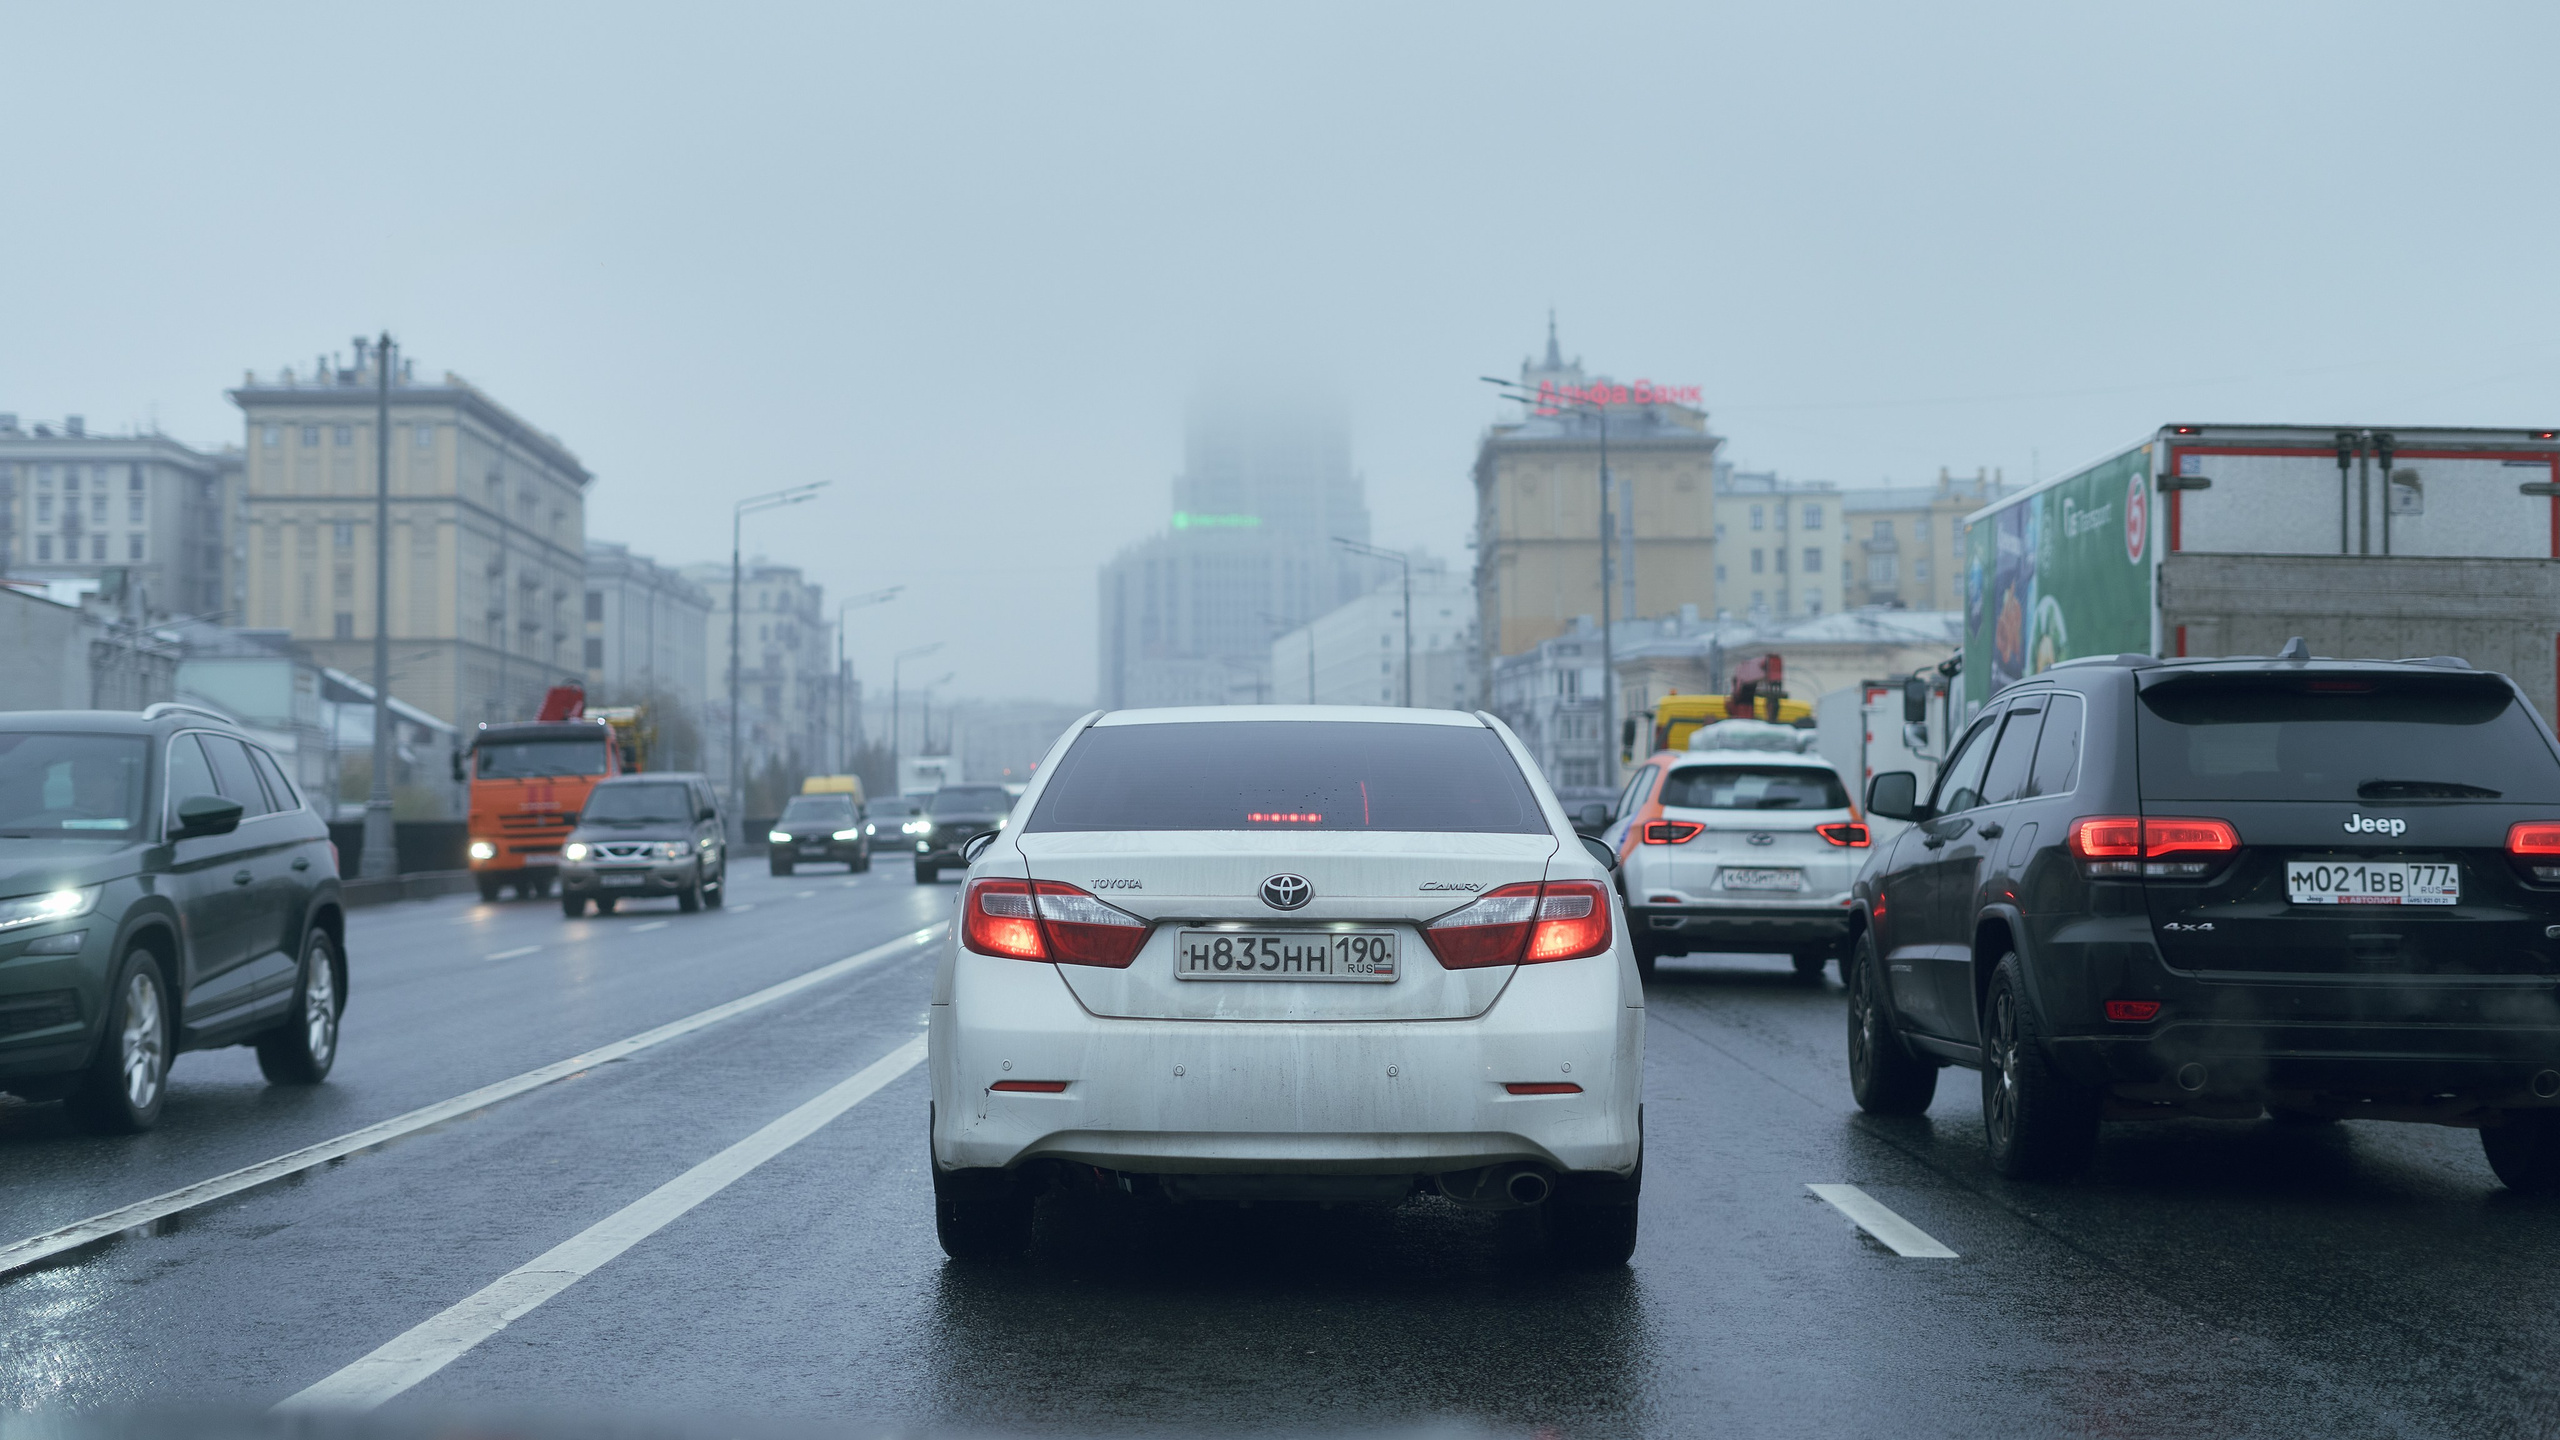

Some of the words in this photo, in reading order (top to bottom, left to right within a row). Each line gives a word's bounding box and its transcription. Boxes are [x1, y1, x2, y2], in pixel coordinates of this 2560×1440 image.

[1634, 379, 1704, 404] Банк
[2343, 813, 2406, 837] Jeep
[1091, 879, 1142, 889] TOYOTA
[2409, 865, 2451, 886] 777
[2420, 886, 2441, 894] RUS
[1335, 937, 1386, 963] 190
[1347, 963, 1374, 974] RUS
